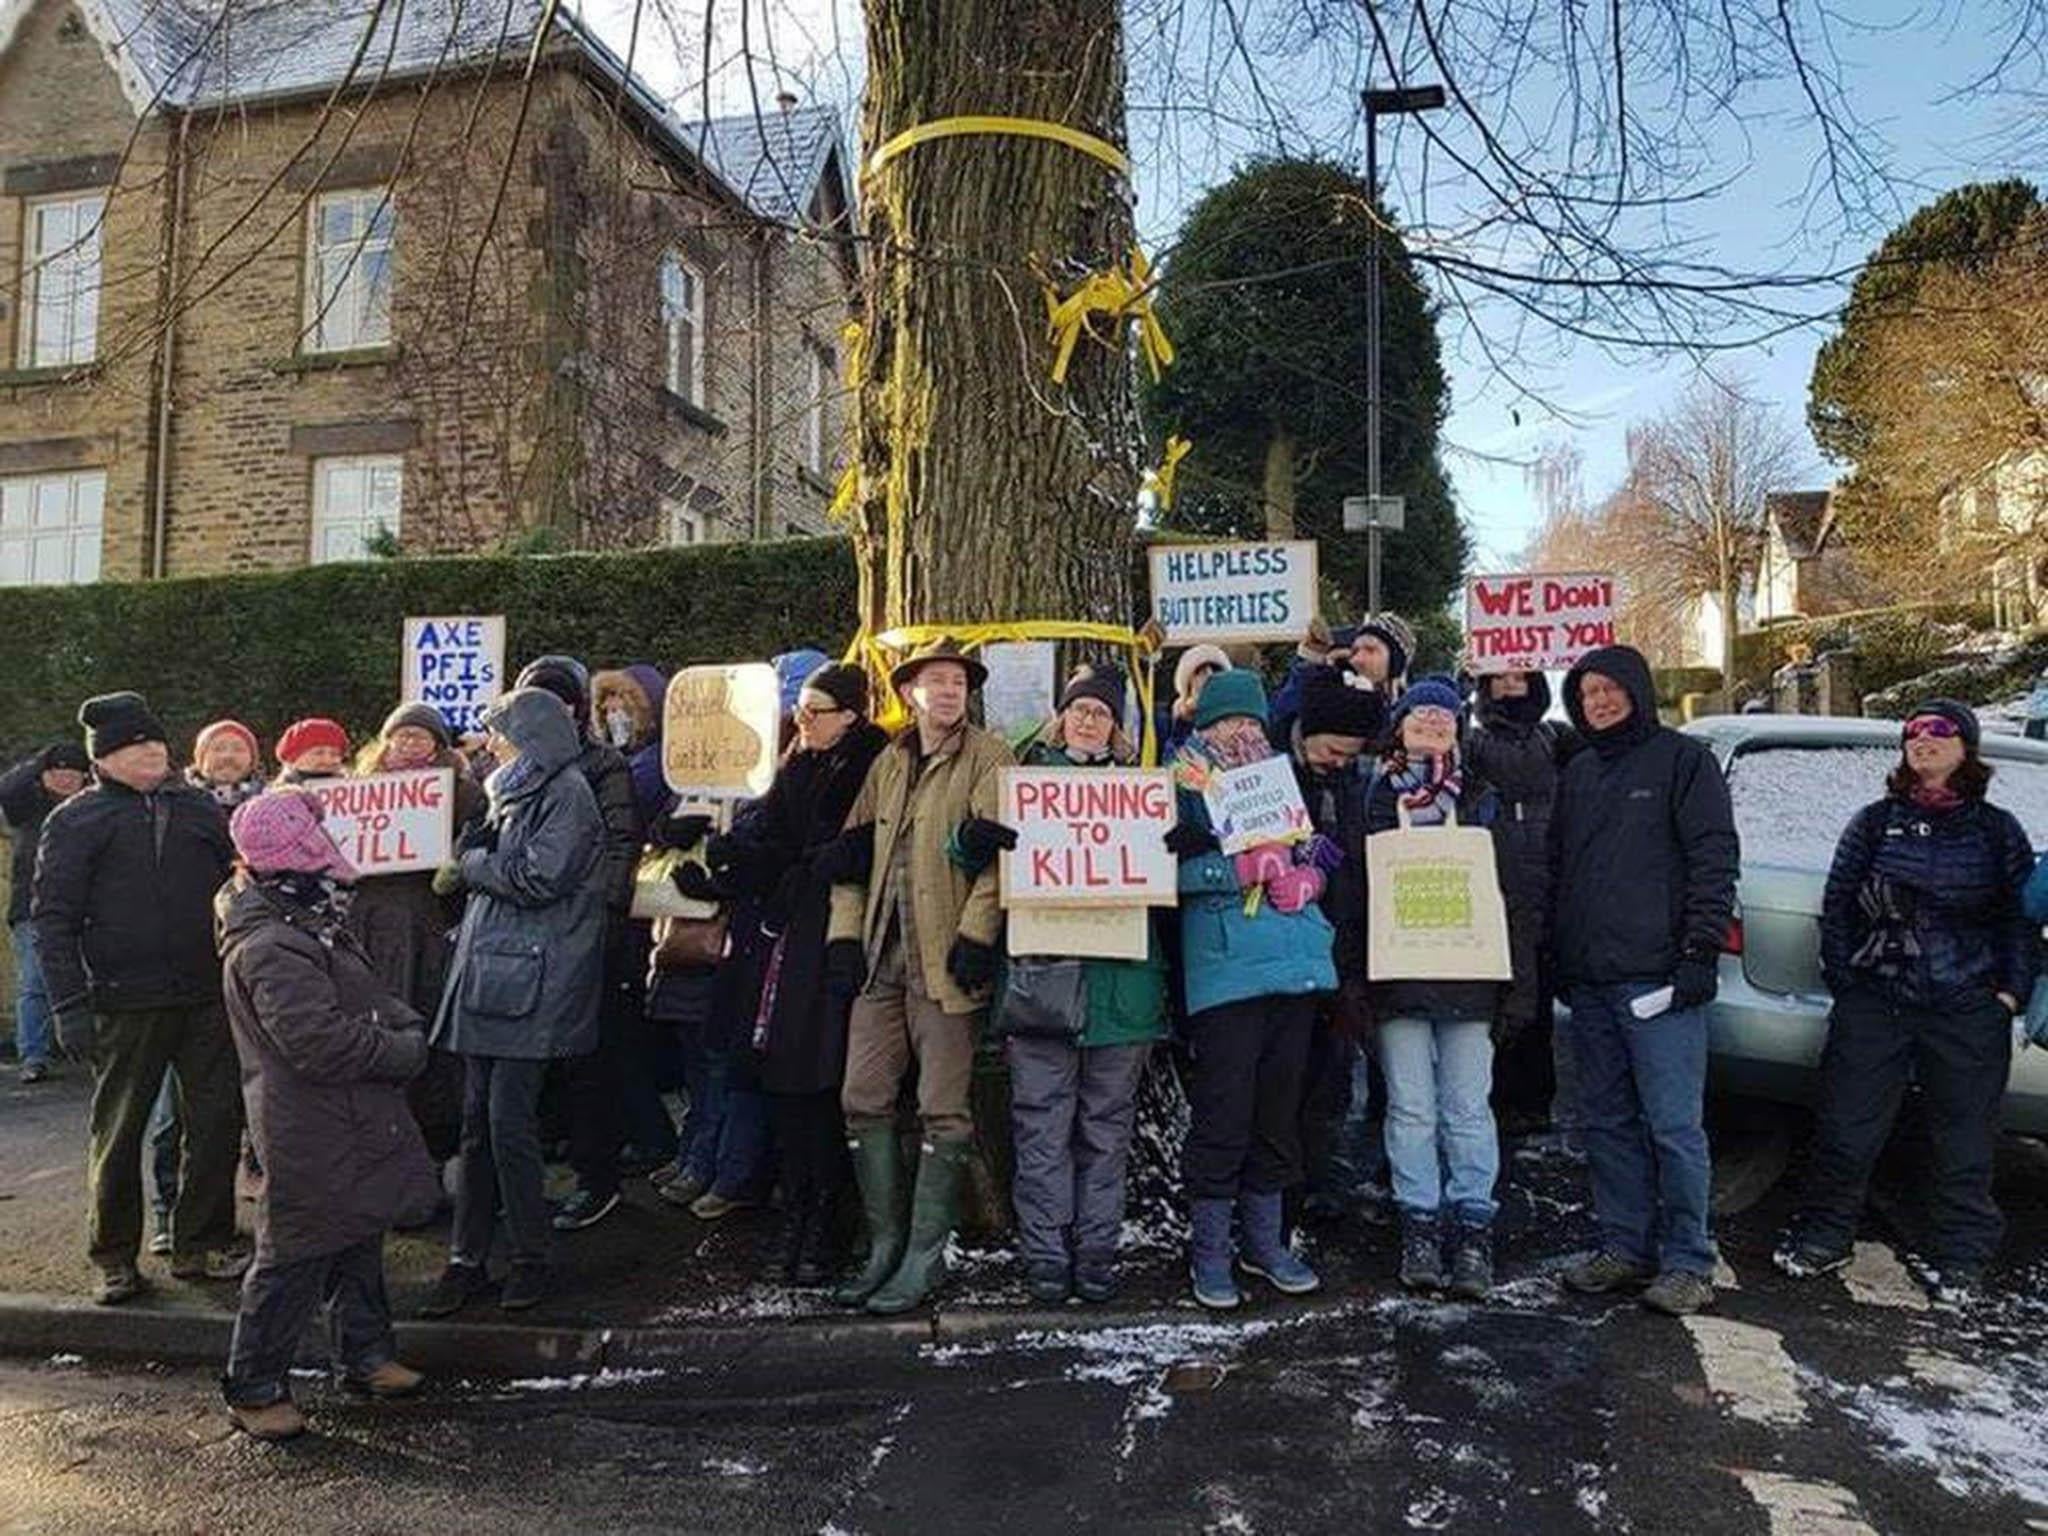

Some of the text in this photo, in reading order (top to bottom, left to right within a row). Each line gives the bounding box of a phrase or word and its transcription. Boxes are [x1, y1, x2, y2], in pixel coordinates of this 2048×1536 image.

[1168, 547, 1288, 583] HELPLESS
[1159, 589, 1290, 627] BUTTERFLIES
[1475, 580, 1534, 617] WE
[417, 621, 483, 650] AXE
[1472, 621, 1616, 657] TRUST YOU
[422, 683, 480, 702] NOT
[317, 776, 443, 817] PRUNING
[1016, 781, 1169, 821] PRUNING
[356, 812, 391, 832] TO
[1067, 821, 1109, 844] TO
[339, 830, 417, 865] ILL
[1033, 844, 1148, 887] KILL
